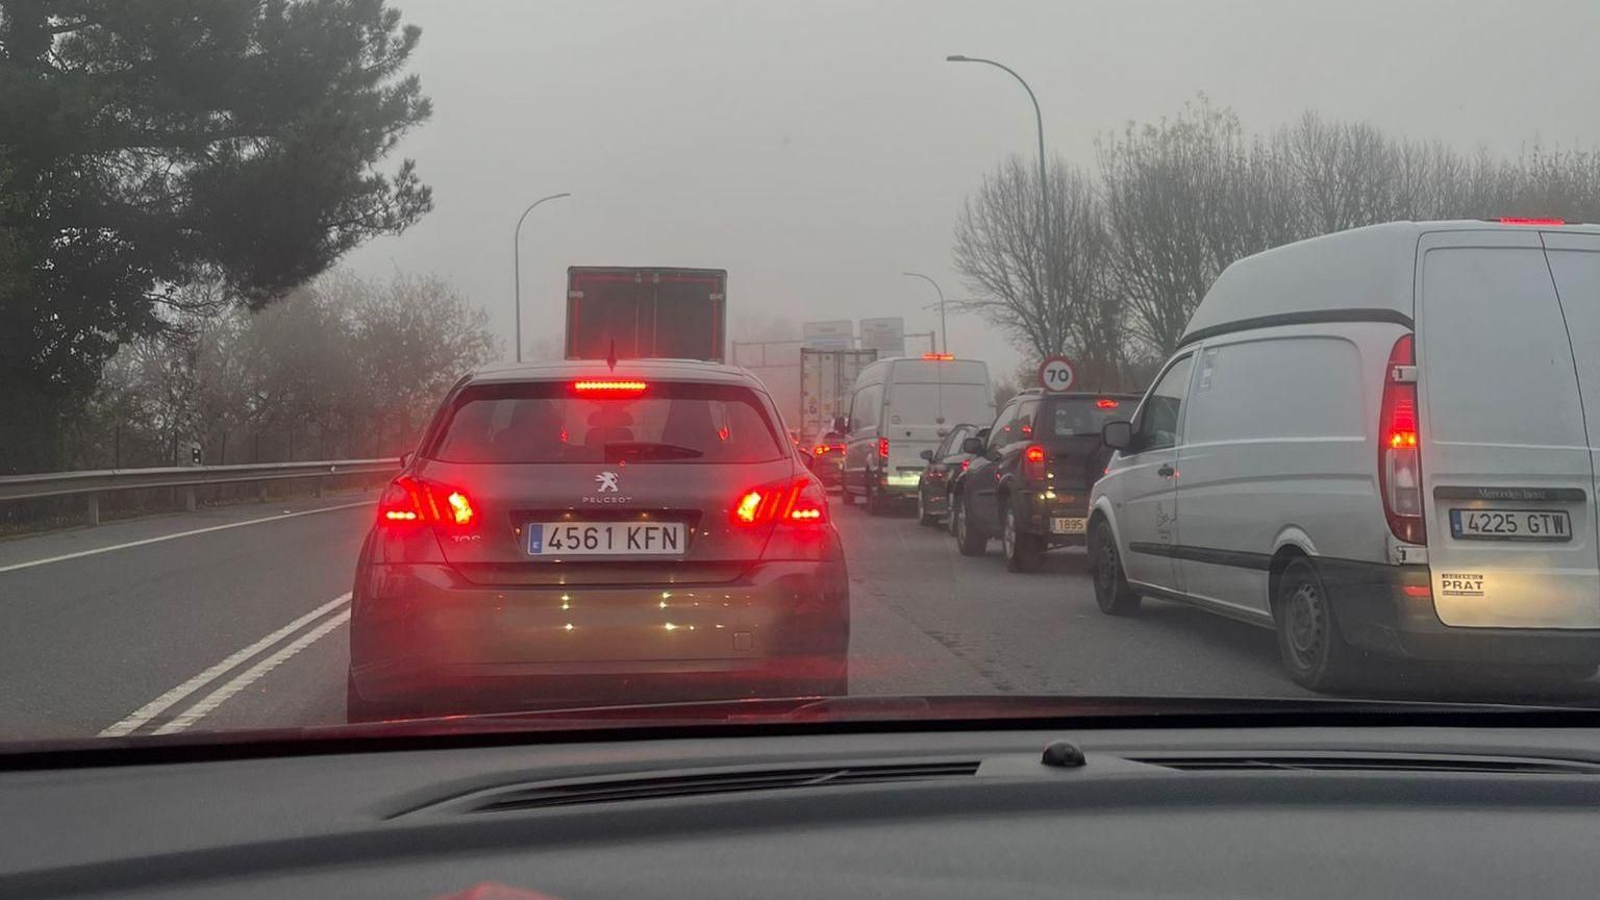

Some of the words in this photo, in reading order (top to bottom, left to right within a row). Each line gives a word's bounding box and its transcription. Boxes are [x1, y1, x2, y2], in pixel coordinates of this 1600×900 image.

[1046, 369, 1070, 383] 70
[1058, 519, 1084, 530] 1895
[1468, 513, 1518, 533] 4225
[1527, 514, 1564, 534] GTW
[548, 526, 613, 550] 4561
[627, 526, 677, 550] KFN
[1442, 580, 1484, 590] PRAT
